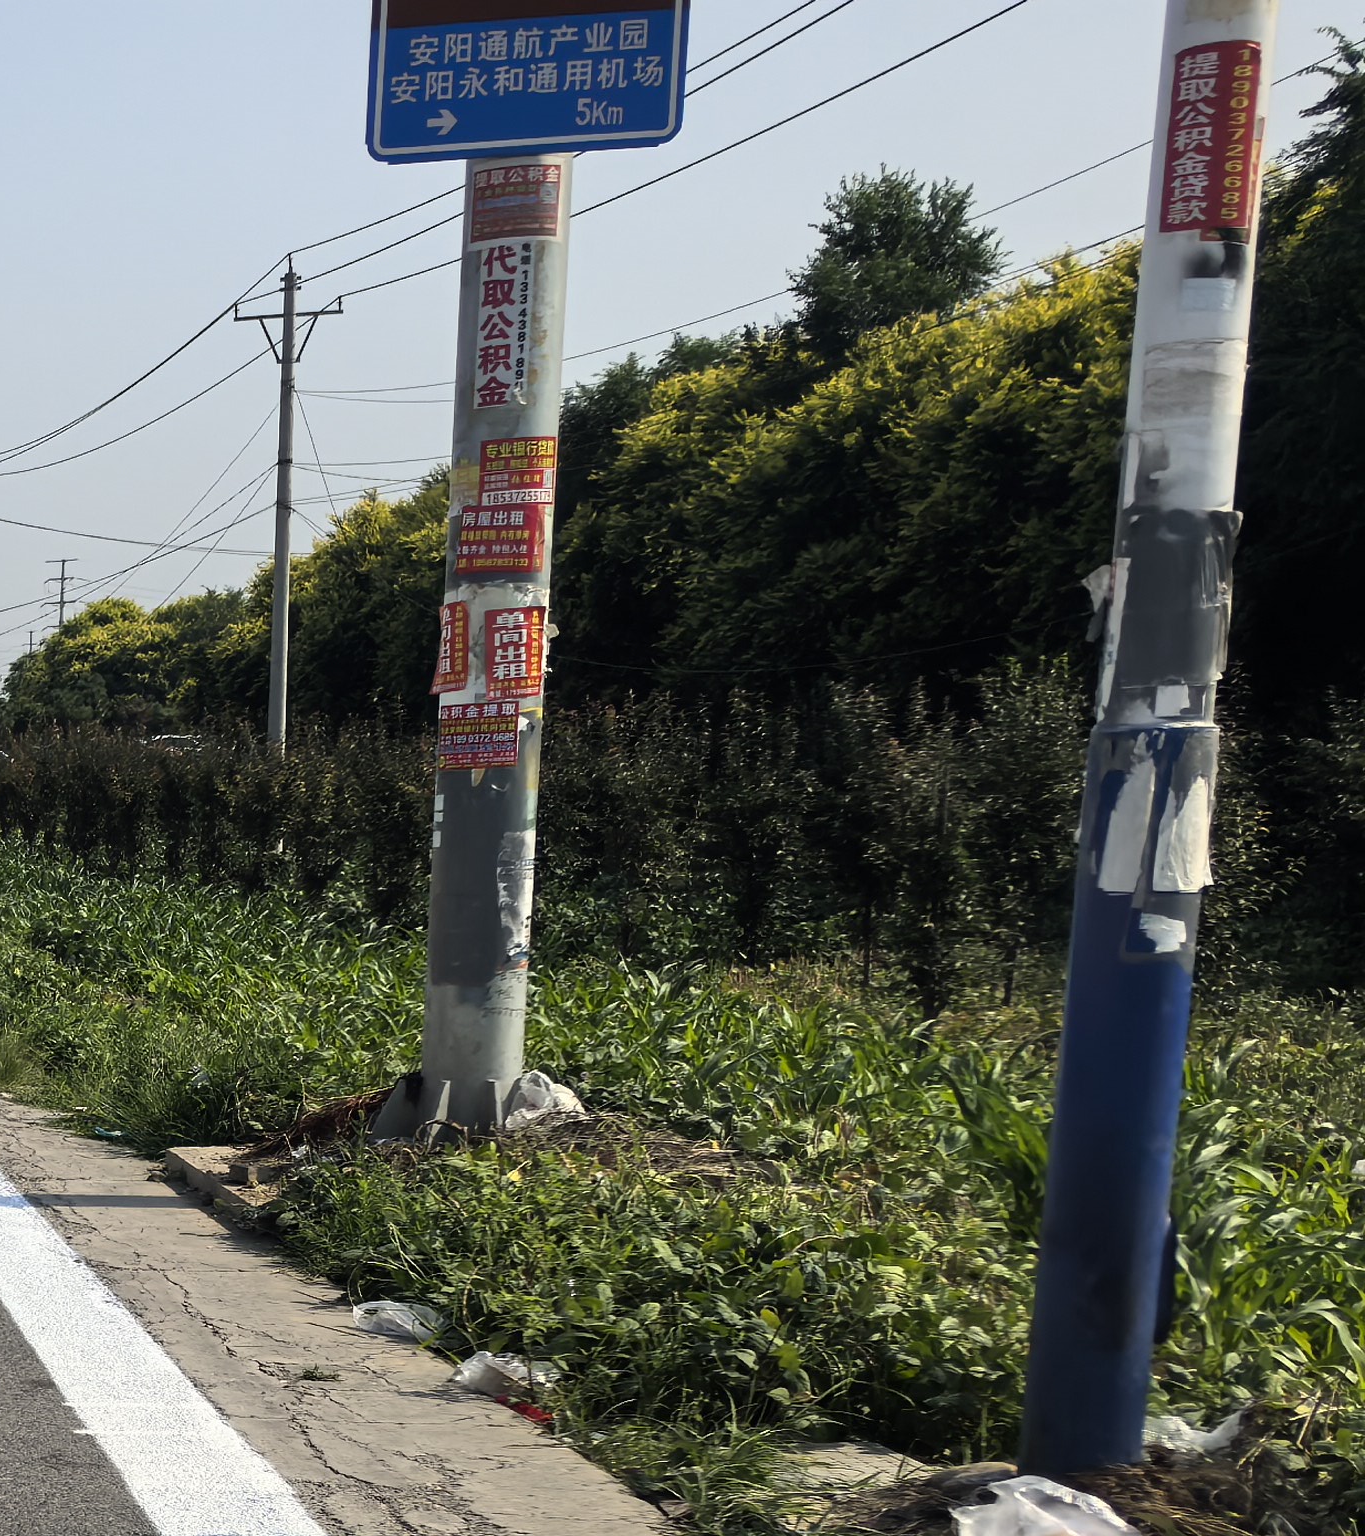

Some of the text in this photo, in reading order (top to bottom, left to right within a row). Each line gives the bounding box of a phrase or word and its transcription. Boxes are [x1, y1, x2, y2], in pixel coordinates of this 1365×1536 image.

[409, 19, 648, 66] 安阳通航产业园
[390, 56, 665, 103] 安阳永和通用机场
[575, 98, 624, 126] 5Km
[1220, 48, 1253, 220] 18903726685
[1167, 51, 1220, 224] 提取公积金贷款
[475, 166, 559, 188] 提取公积金
[477, 245, 518, 408] 代取公积金
[462, 510, 524, 527] 房屋出租
[492, 611, 529, 680] 单间出租
[441, 703, 516, 719] 公积金提取
